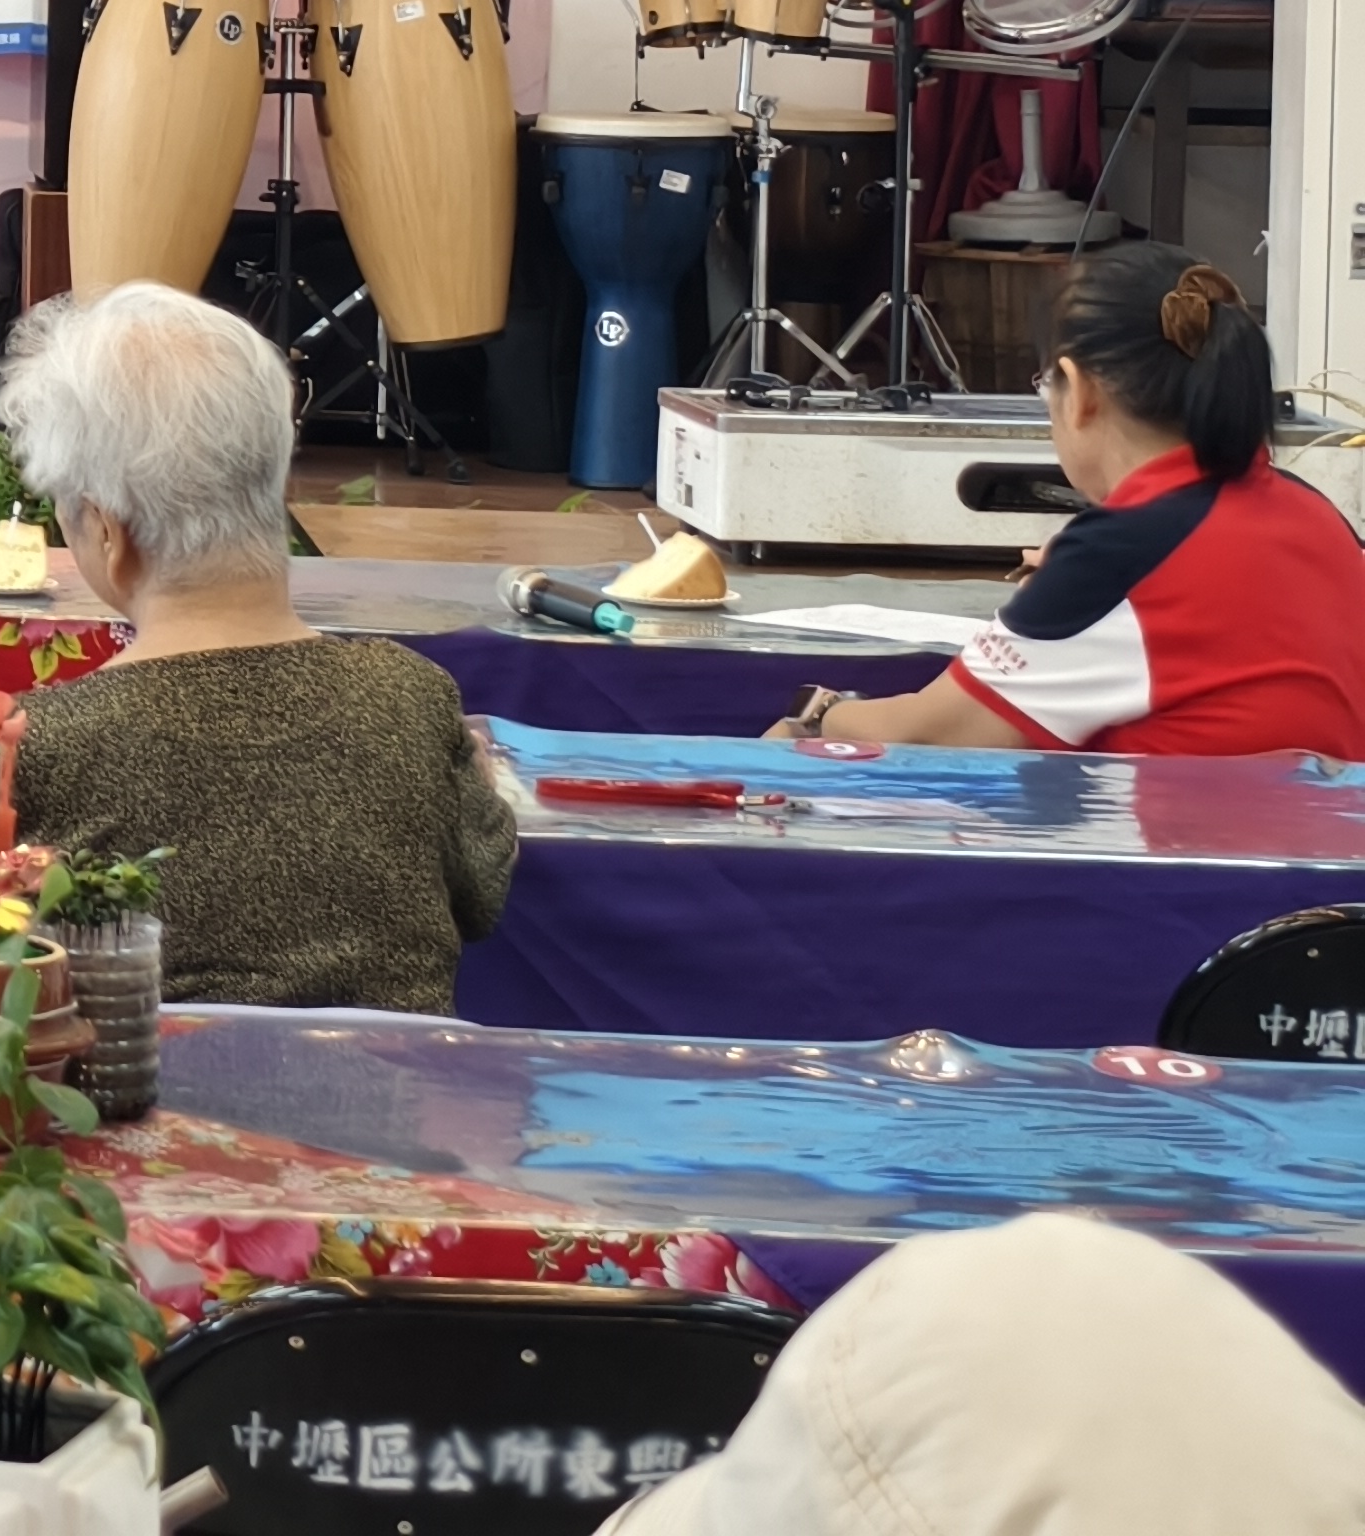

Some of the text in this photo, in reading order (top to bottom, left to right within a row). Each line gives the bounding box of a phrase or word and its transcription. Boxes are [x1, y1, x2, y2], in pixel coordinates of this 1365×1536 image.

[1259, 1004, 1365, 1060] 中壢
[1110, 1055, 1208, 1079] 10
[231, 1410, 725, 1501] 中壢區公所東興
